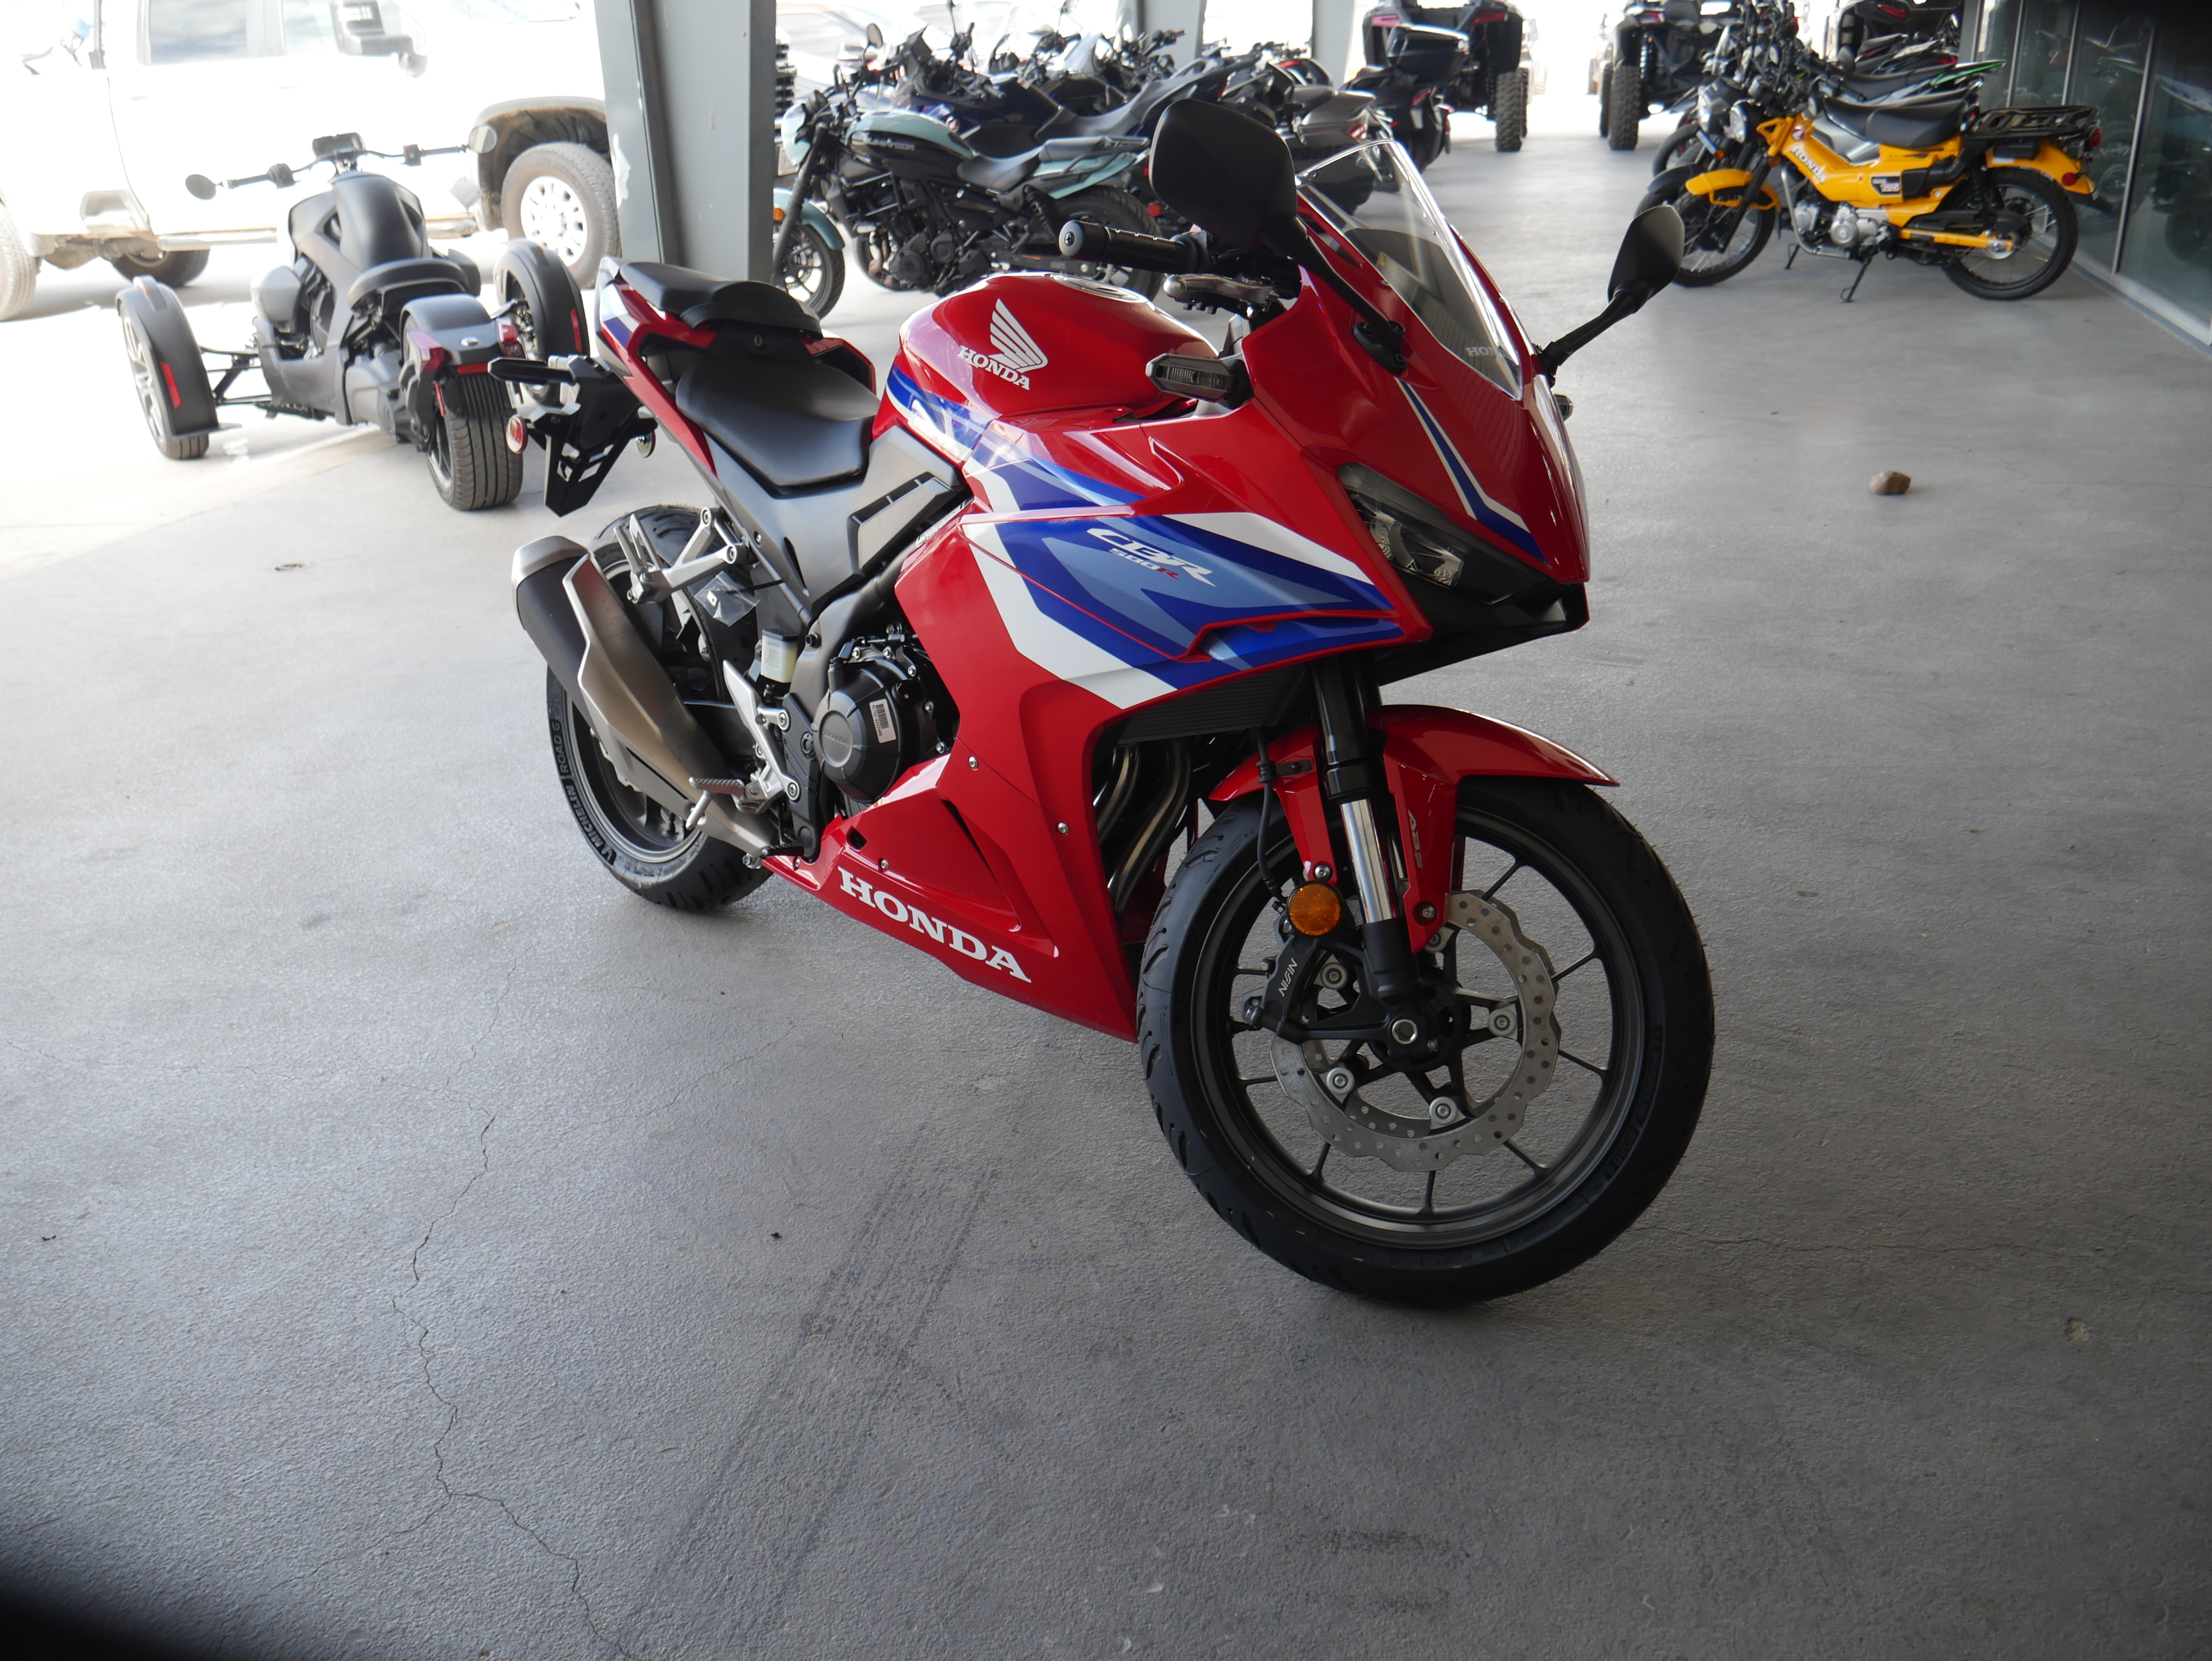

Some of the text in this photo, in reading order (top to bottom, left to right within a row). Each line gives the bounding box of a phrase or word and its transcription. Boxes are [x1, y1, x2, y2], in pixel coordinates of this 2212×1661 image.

[1790, 145, 1826, 184] HONDA
[957, 345, 1030, 391] HONDA
[1086, 528, 1217, 587] CBR
[1109, 548, 1180, 580] 500R
[552, 722, 570, 774] ROAD 6
[824, 730, 849, 747] HONDA
[566, 784, 604, 848] MICHELIN
[1407, 810, 1423, 870] ABS
[837, 866, 1032, 983] HONDA
[1277, 958, 1299, 998] NISSIN
